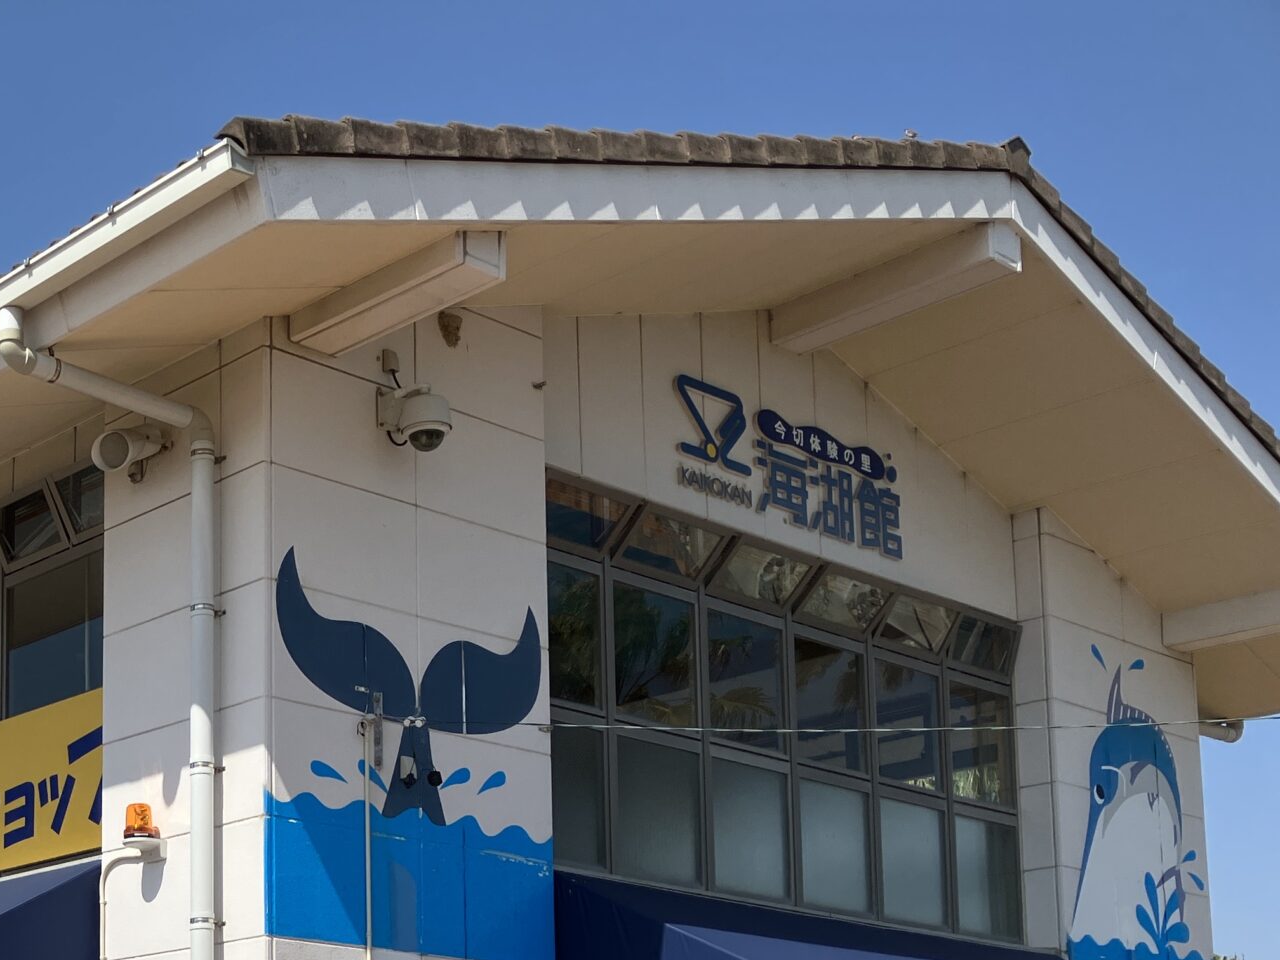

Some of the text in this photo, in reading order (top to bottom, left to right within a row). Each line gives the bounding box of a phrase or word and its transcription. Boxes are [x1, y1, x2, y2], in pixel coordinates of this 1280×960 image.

[774, 420, 872, 473] 今切体験の里
[679, 466, 753, 508] KAIKOKAN
[754, 440, 903, 560] 海湖館
